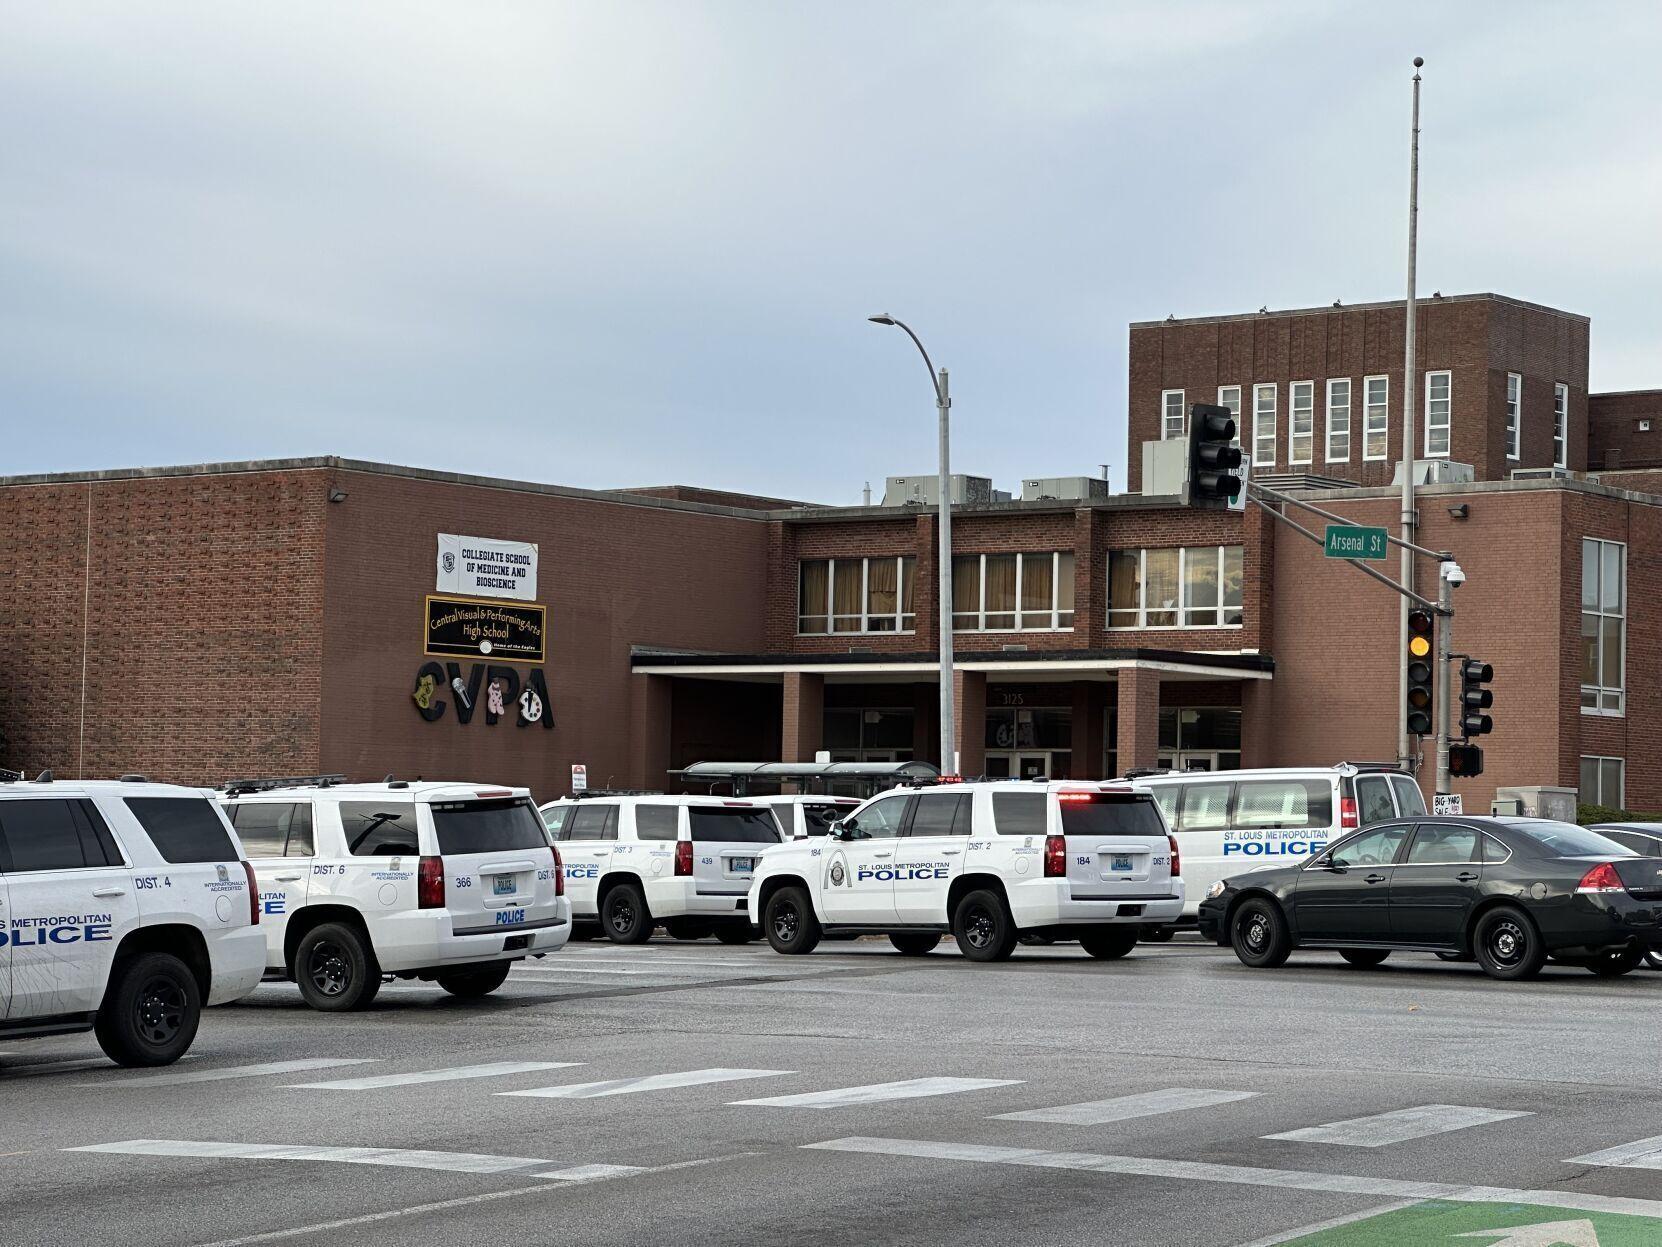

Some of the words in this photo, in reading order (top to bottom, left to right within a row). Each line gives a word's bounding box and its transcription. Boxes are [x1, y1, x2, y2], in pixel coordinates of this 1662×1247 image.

[1330, 533, 1364, 551] Arsenal
[1370, 535, 1381, 552] St
[461, 549, 504, 562] COLLEGIATE
[505, 553, 531, 566] SCHOOL
[466, 562, 475, 572] OF
[476, 563, 510, 576] MEDICINE
[511, 567, 526, 578] AND
[476, 576, 516, 590] BIOSCIENCE
[430, 608, 458, 630] Central
[457, 606, 480, 620] Visual
[480, 609, 487, 620] &
[487, 608, 525, 631] Performing
[524, 621, 541, 636] Arts
[463, 621, 481, 641] High
[482, 622, 509, 638] School
[413, 661, 555, 729] CVPA
[1434, 796, 1445, 806] BIG
[1447, 795, 1460, 805] YARD
[1224, 831, 1236, 840] ST.
[1239, 830, 1262, 840] LOUIS
[1265, 829, 1328, 840] METROPOLITAN
[986, 842, 991, 850] 2
[811, 849, 821, 857] 184
[701, 857, 713, 865] 439
[1076, 856, 1091, 865] 184
[1166, 857, 1170, 865] 2
[313, 865, 334, 875] DIST.
[338, 865, 345, 874] 6
[551, 869, 555, 879] 6
[563, 869, 599, 878] ICE
[858, 868, 949, 881] POLICE
[135, 877, 162, 889] DIST.
[164, 876, 172, 888] 4
[204, 880, 247, 888] INTERNATIONALLY
[456, 877, 472, 888] 366
[497, 879, 512, 891] POLICE
[12, 914, 112, 928] METROPOLITAN
[496, 909, 525, 925] POLICE
